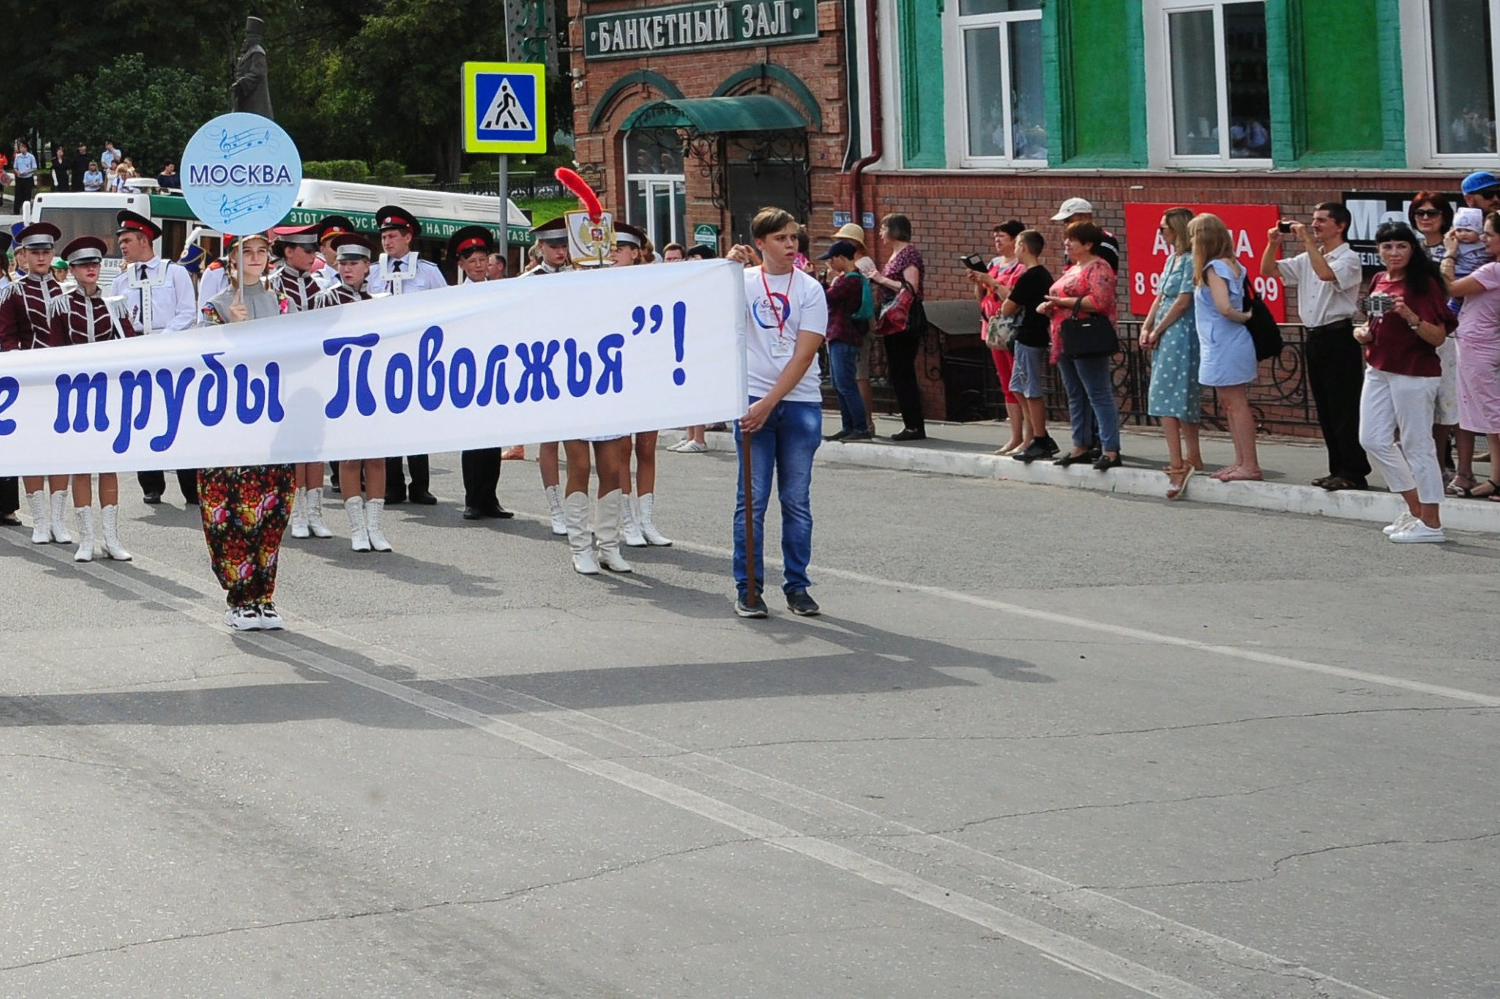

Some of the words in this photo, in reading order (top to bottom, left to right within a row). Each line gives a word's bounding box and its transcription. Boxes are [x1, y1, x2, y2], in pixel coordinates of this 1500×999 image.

[598, 1, 730, 52] БАНКЕТНЫЙ
[742, 0, 787, 39] ЗАЛ
[189, 164, 293, 184] МОСКВА
[290, 211, 317, 225] ЭТОТ
[426, 223, 440, 236] НА
[507, 229, 531, 243] ГАЗЕ
[53, 352, 285, 454] трубы
